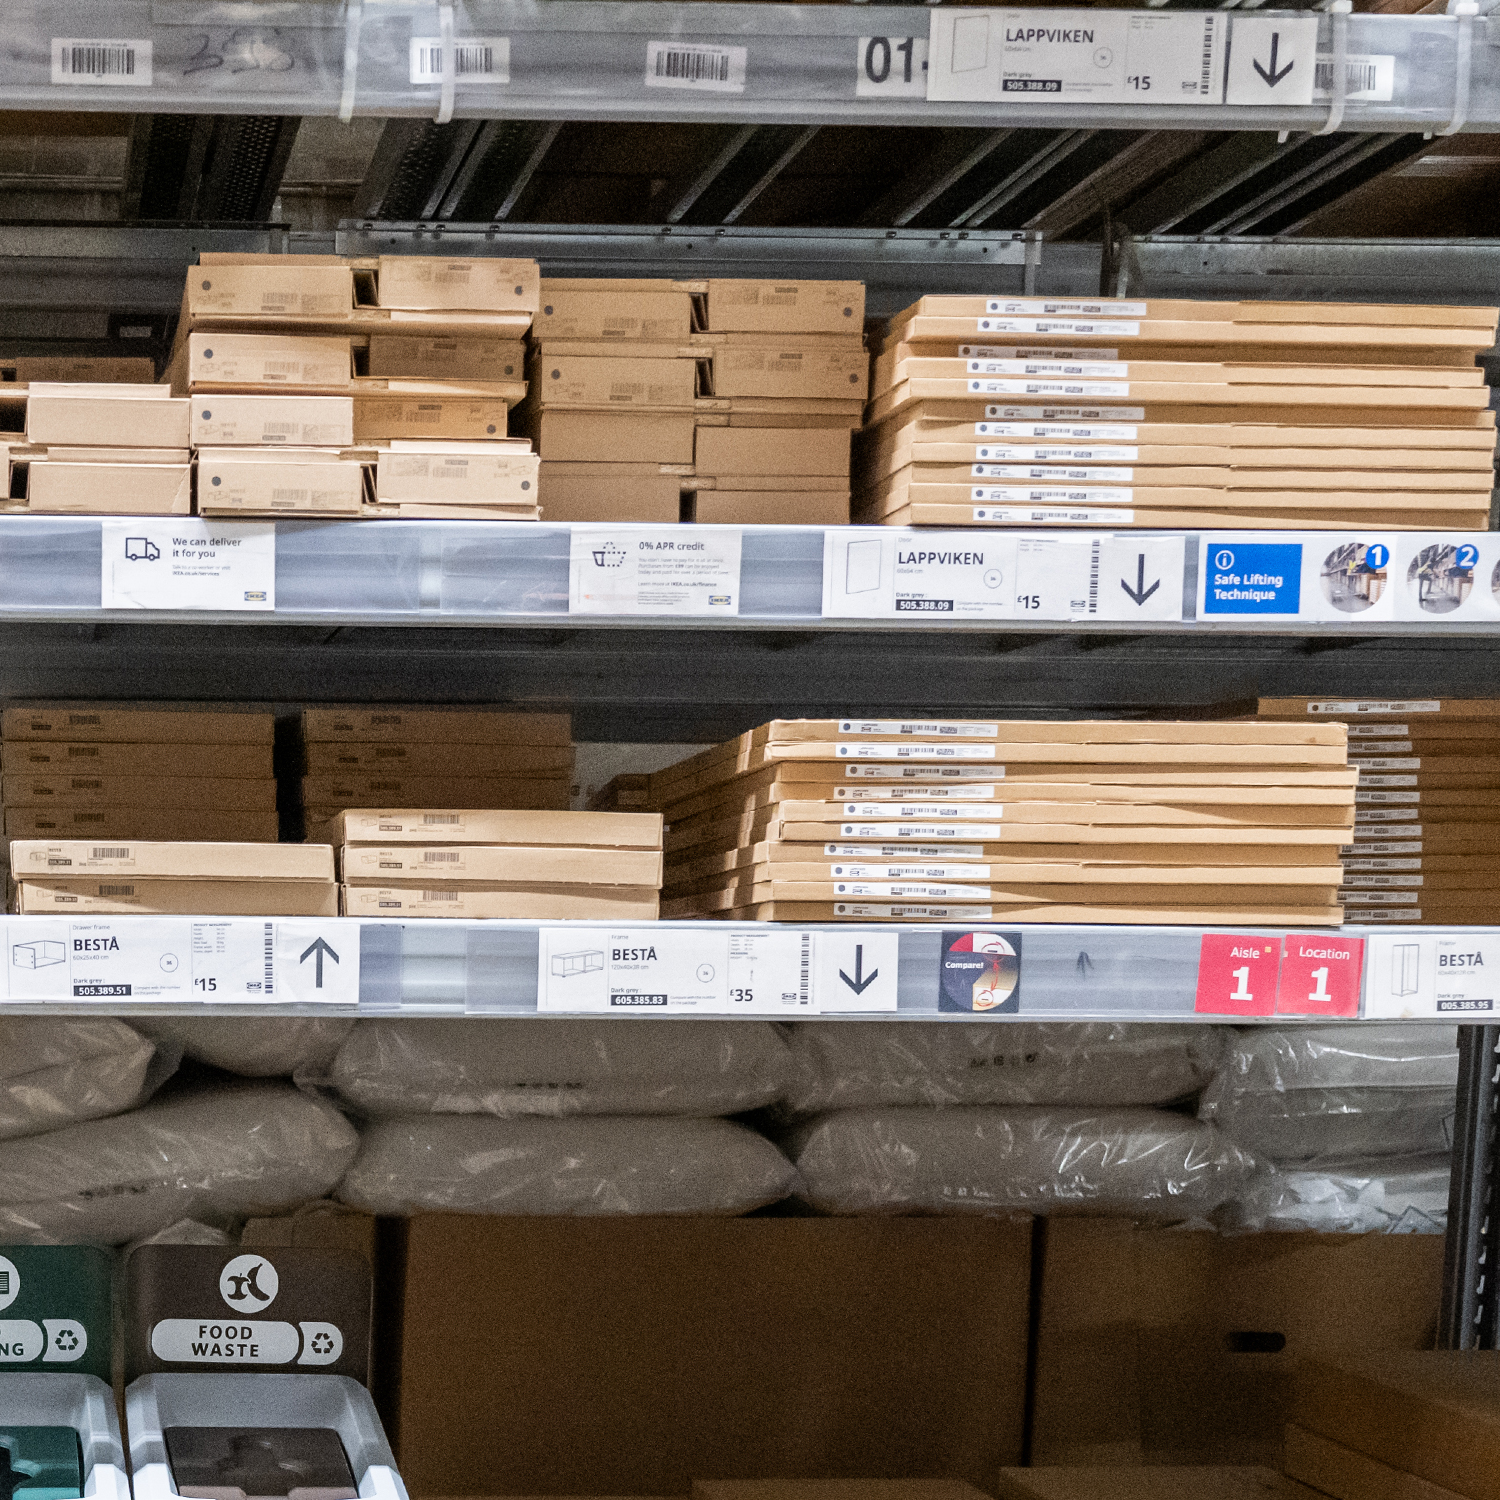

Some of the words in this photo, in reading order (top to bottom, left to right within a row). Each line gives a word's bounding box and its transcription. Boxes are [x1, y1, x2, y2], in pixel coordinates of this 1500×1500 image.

[1006, 29, 1094, 43] LAPPVIKEN
[1006, 81, 1058, 91] 505.388.09
[1128, 76, 1151, 90] £15
[173, 538, 188, 546] We
[210, 538, 242, 547] deliver
[639, 542, 654, 550] 0%
[656, 542, 674, 550] APR
[677, 542, 704, 551] credit
[173, 549, 179, 557] it
[182, 549, 195, 557] for
[198, 551, 216, 560] you
[899, 552, 984, 565] LAPPVIKEN
[1371, 546, 1382, 565] 1
[1460, 546, 1474, 567] 2
[1215, 574, 1240, 586] Safe
[1244, 574, 1283, 587] Lifting
[1214, 589, 1276, 602] Technique
[900, 601, 950, 610] 505.388.09
[1017, 596, 1040, 609] £15
[74, 936, 120, 951] BESTÅ
[613, 946, 658, 961] BESTÅ
[1231, 947, 1260, 959] Aisle
[1300, 947, 1350, 960] Location
[1440, 951, 1484, 966] BESTÅ
[195, 978, 217, 991] £15
[1230, 967, 1253, 1001] 1
[1308, 967, 1331, 1002] 1
[79, 987, 126, 995] 505.389.51
[730, 989, 754, 1002] £35
[1442, 1002, 1489, 1010] 005.385.95
[199, 1326, 253, 1340] FOOD
[191, 1343, 260, 1358] WASTE
